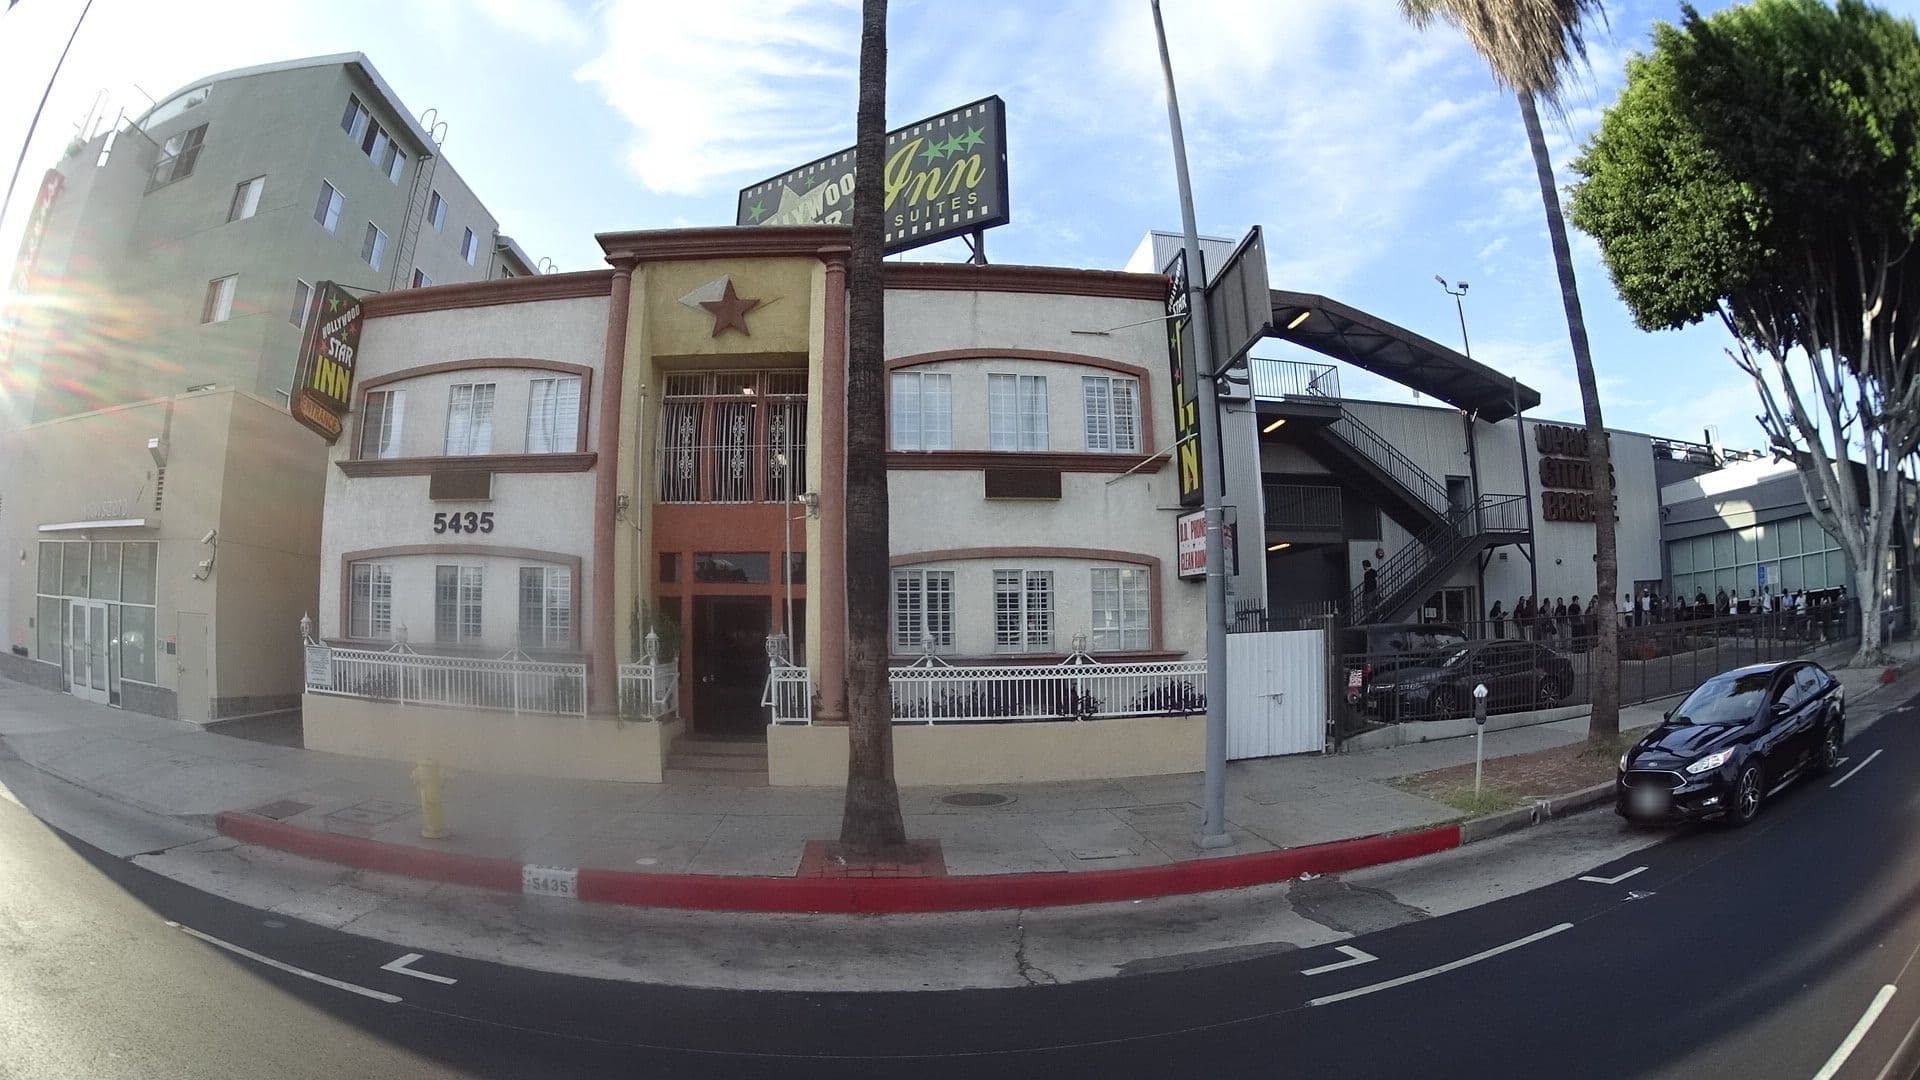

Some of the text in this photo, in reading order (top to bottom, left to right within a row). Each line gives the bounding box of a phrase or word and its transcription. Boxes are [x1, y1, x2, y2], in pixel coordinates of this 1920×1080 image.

[885, 138, 986, 212] Inn
[894, 192, 978, 227] SUITES
[322, 304, 361, 339] HOLLYWOOD
[328, 337, 354, 367] STAR
[314, 354, 351, 404] INN
[301, 396, 338, 433] ENTRANCE
[1534, 423, 1611, 458] UPRIG
[1539, 456, 1616, 490] CITIZES
[433, 511, 494, 534] 5435
[1541, 491, 1620, 523] BRIGA
[532, 877, 569, 894] 5435
